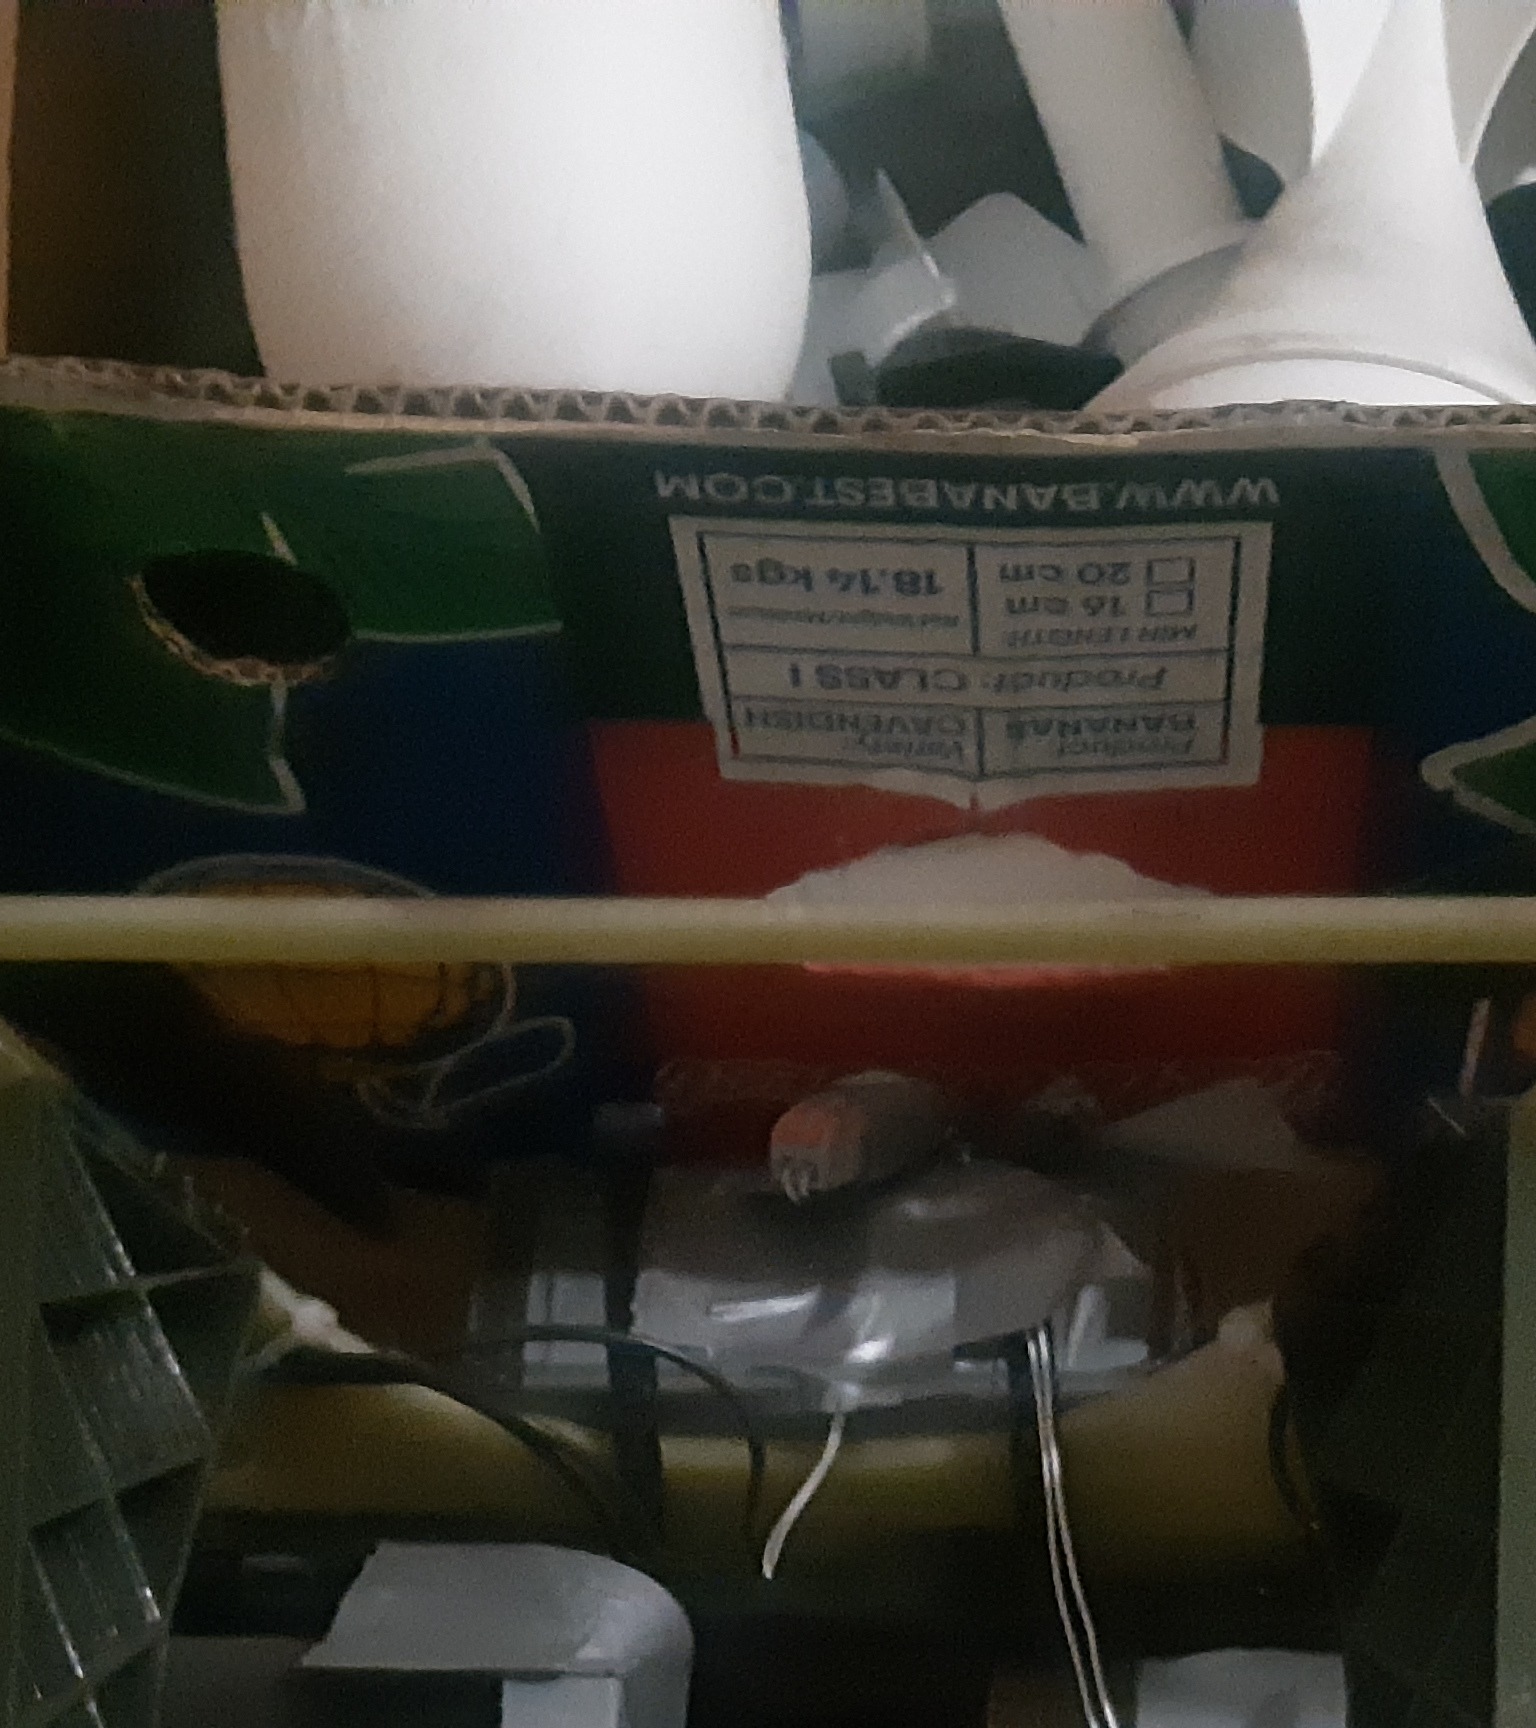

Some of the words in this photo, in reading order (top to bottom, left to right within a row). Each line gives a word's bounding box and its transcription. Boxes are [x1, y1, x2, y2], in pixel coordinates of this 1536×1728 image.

[653, 470, 1280, 511] WWW.BANABEST.COM
[729, 558, 814, 592] kgs
[826, 569, 943, 597] 18.14
[999, 563, 1063, 584] cm
[1077, 562, 1132, 586] 20
[1006, 597, 1070, 617] cm
[1082, 596, 1126, 618] 16
[788, 662, 802, 689] I
[815, 663, 969, 692] CLASS
[744, 706, 967, 736] CAVENDISH
